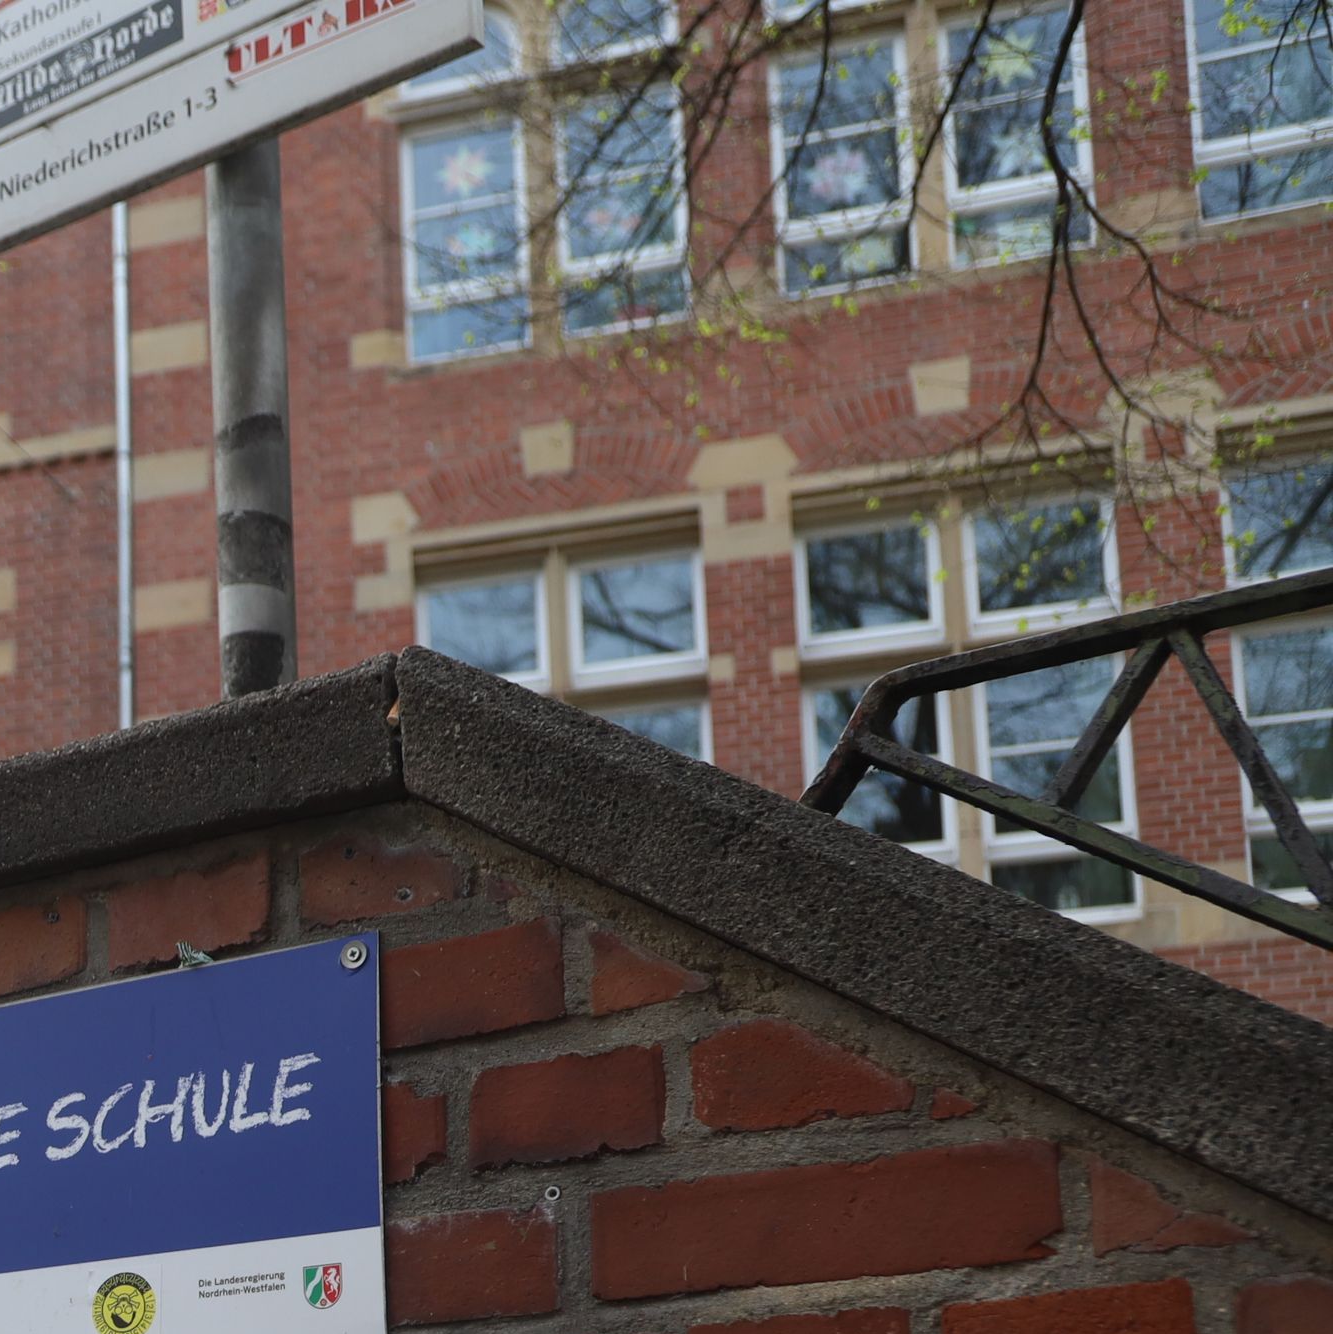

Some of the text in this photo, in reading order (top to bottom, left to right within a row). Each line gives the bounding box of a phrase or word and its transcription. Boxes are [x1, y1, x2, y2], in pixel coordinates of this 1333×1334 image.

[0, 86, 218, 200] Niederichstraße 1-3
[44, 1051, 322, 1163] SCHULE
[198, 1271, 285, 1288] Die Landesregierung
[198, 1283, 286, 1299] Nordrhein-Westfalen
